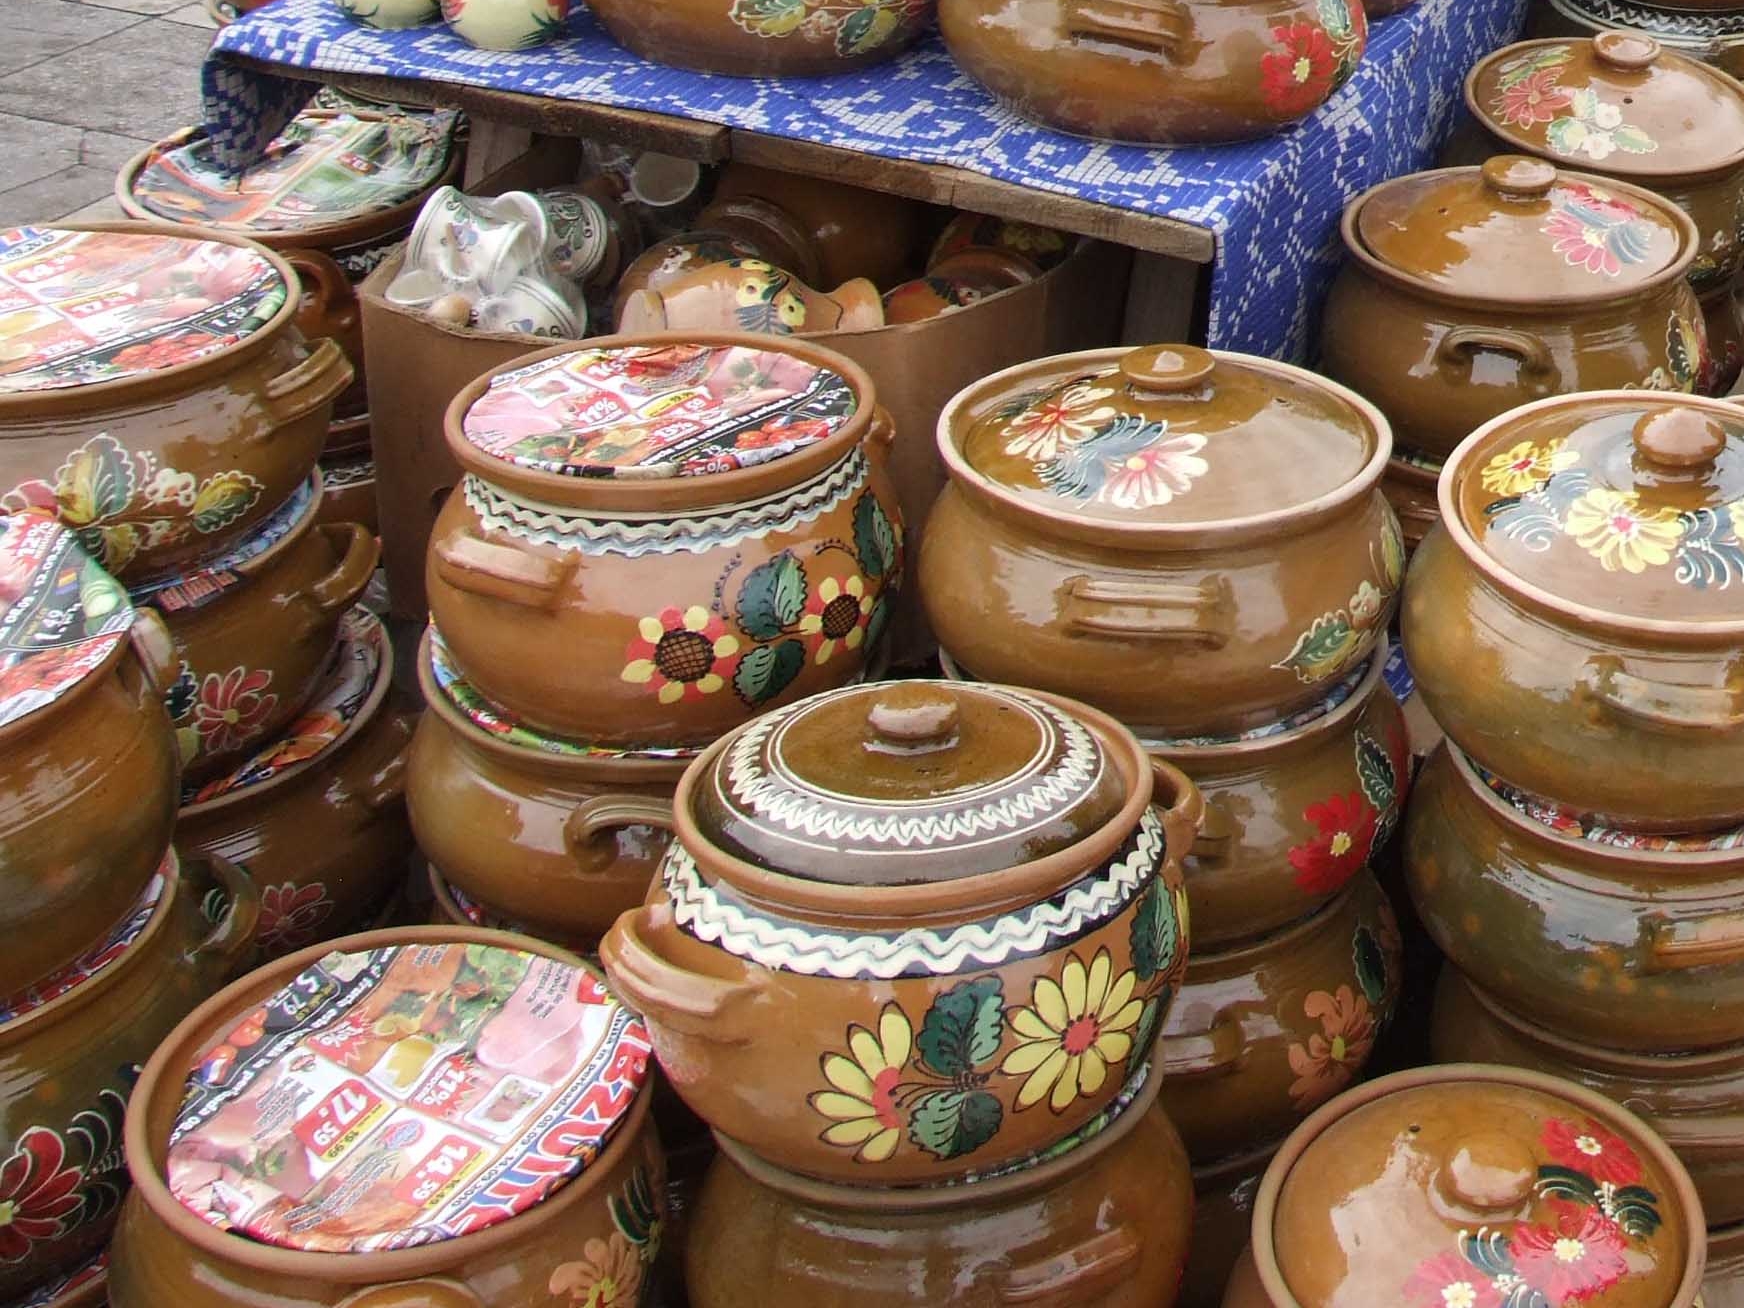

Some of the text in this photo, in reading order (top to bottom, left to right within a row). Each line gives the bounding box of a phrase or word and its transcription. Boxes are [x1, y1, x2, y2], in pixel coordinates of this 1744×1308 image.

[578, 396, 618, 424] 11%
[421, 1067, 464, 1106] 11%
[308, 1087, 367, 1147] 17.59
[519, 1113, 554, 1146] 08.09
[324, 1129, 359, 1159] 19.99
[409, 1144, 468, 1202] 14.59
